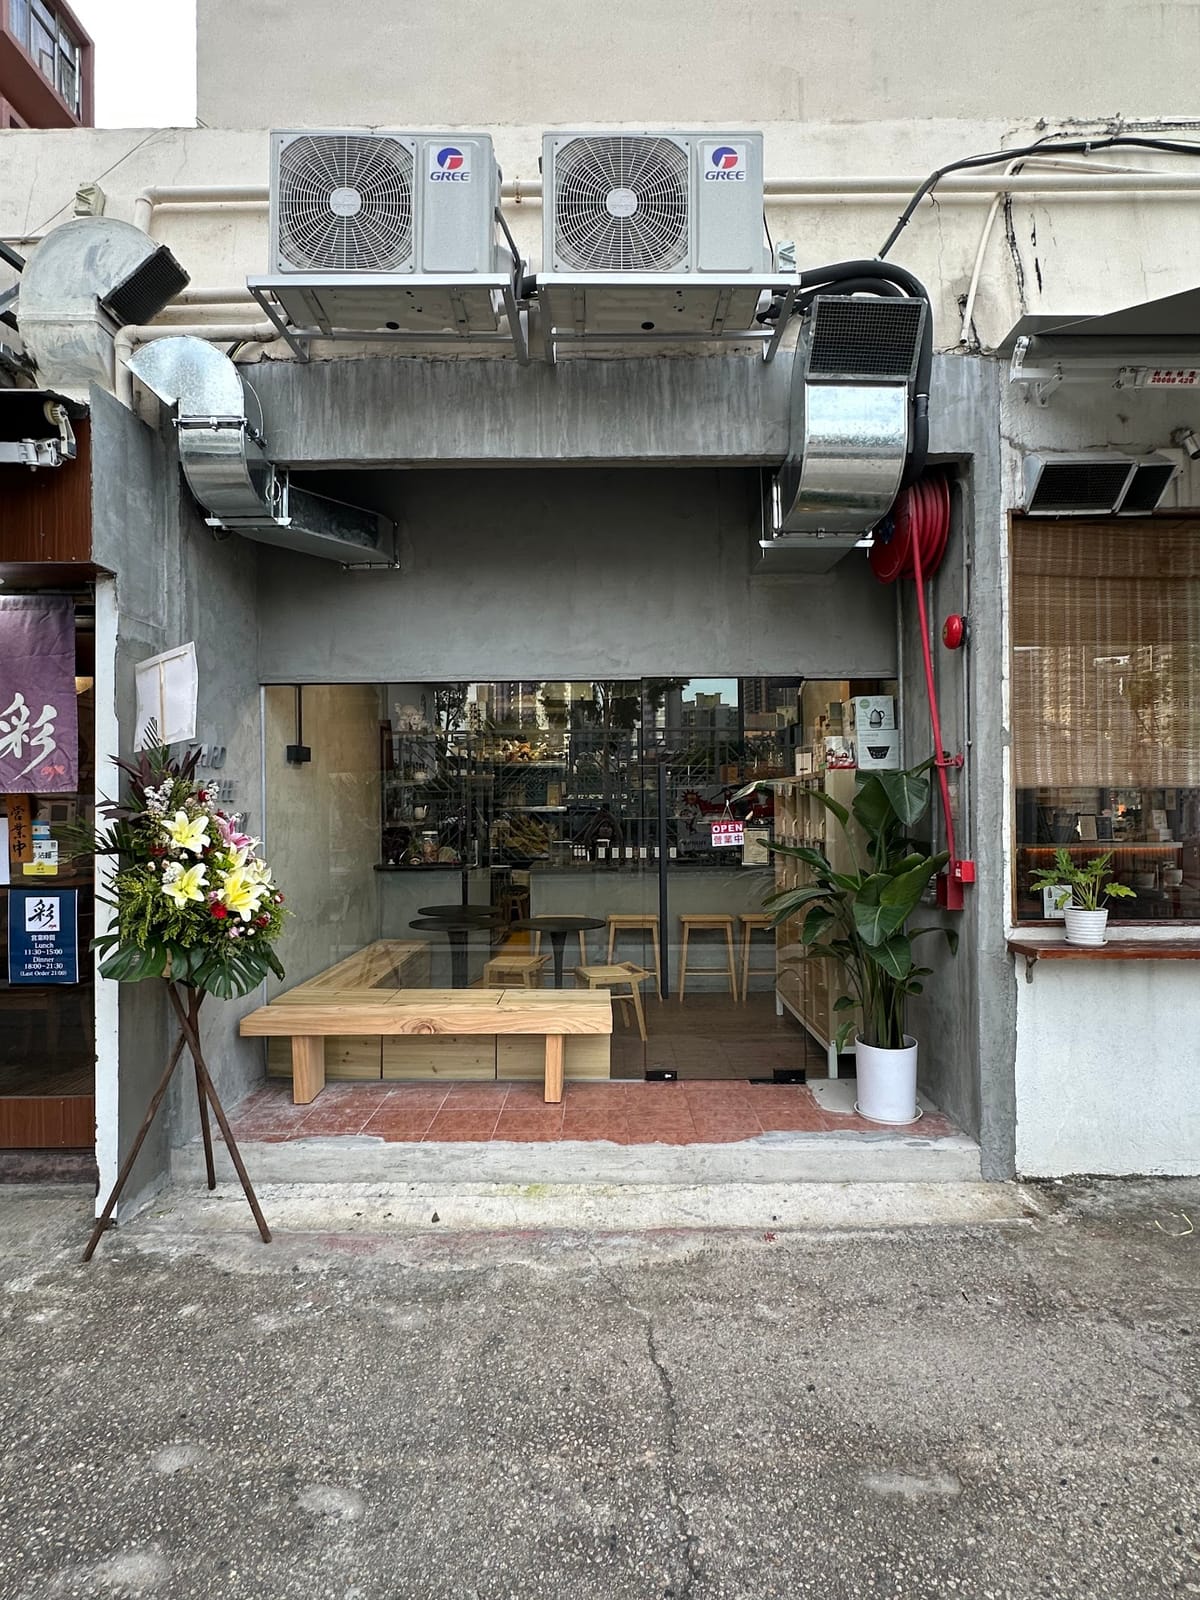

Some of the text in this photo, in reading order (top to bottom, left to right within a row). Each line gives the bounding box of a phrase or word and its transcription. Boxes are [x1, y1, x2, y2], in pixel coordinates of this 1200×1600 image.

[430, 171, 471, 181] GREE
[705, 170, 745, 181] GREE
[0, 692, 58, 784] 彩
[712, 823, 743, 833] OPEN
[28, 898, 55, 930] 彩
